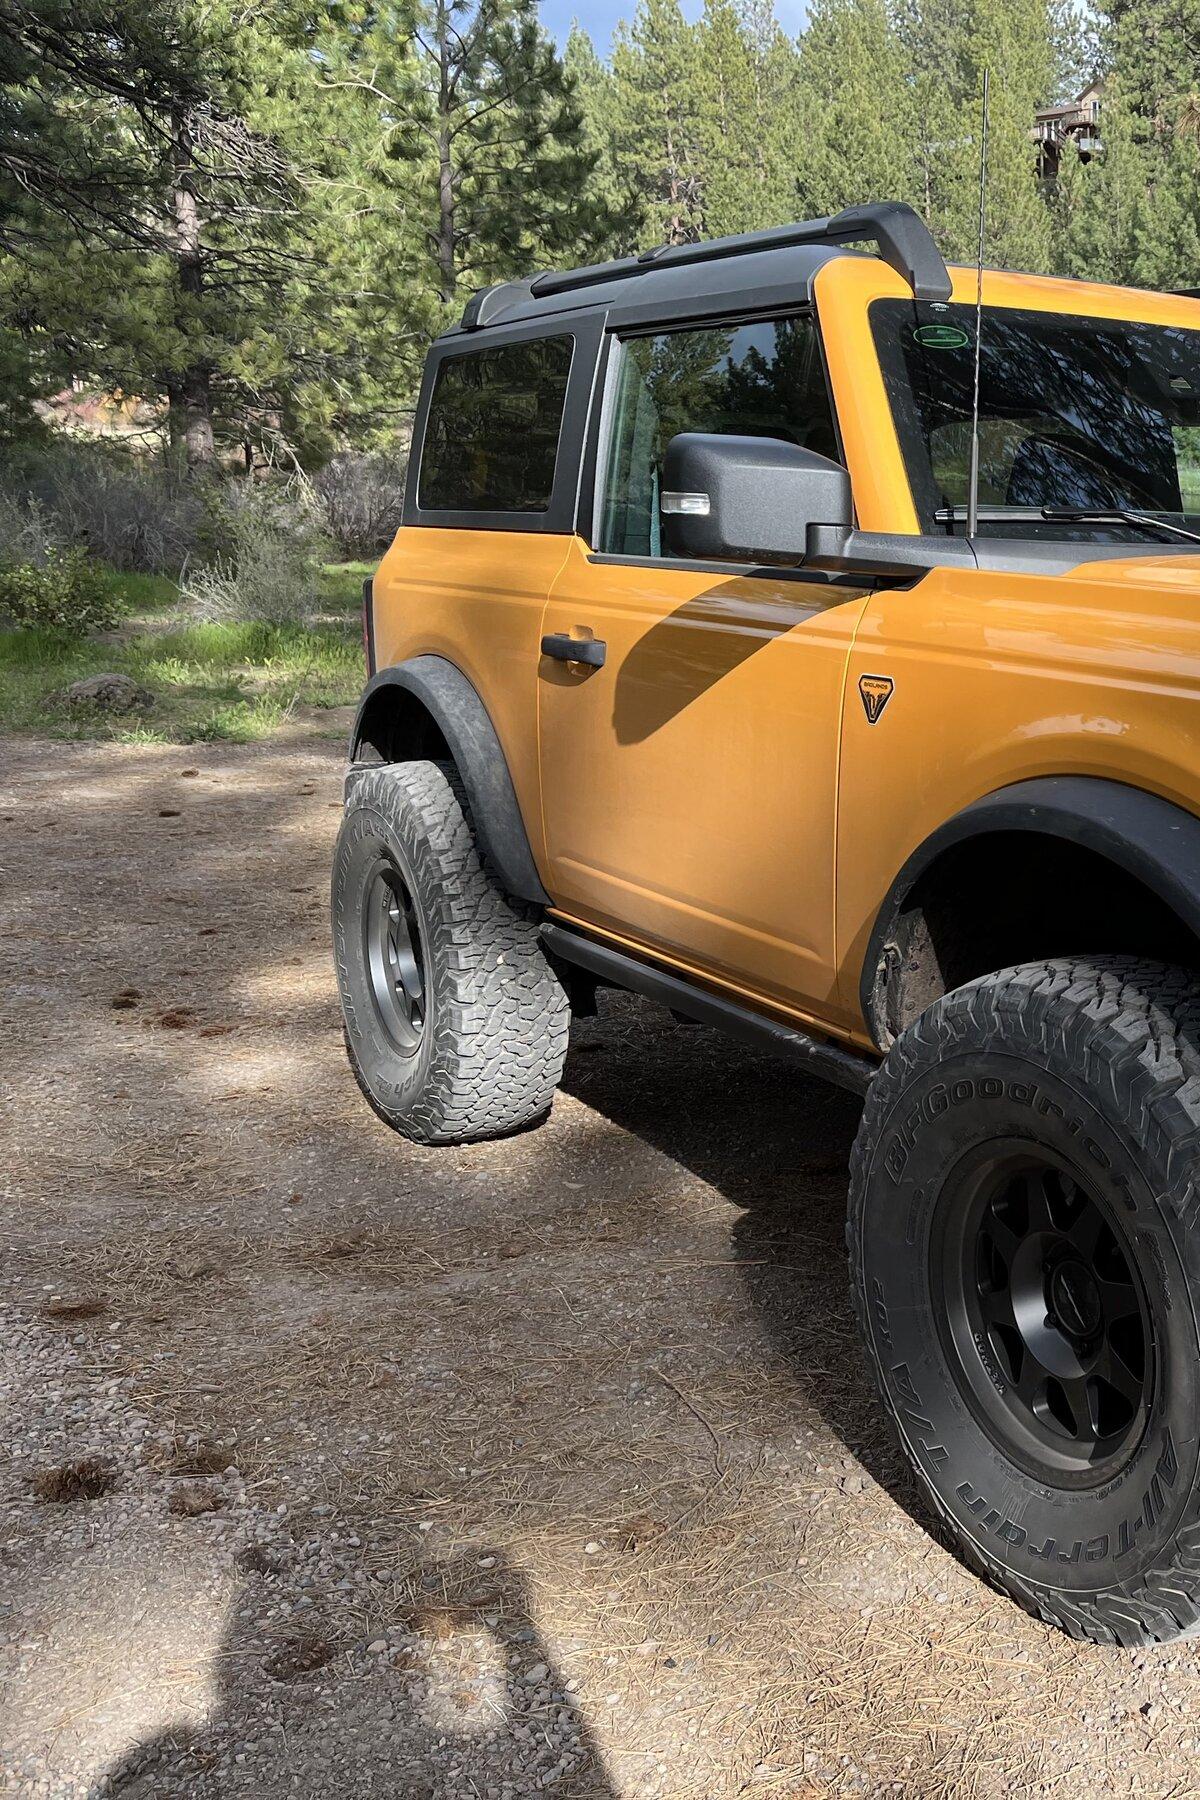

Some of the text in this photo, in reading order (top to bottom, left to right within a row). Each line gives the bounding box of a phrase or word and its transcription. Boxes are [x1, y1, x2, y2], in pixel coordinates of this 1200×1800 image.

[883, 1074, 1138, 1212] BFGoodrich
[890, 1360, 951, 1473] T/A
[955, 1426, 1178, 1566] All-Terrain
